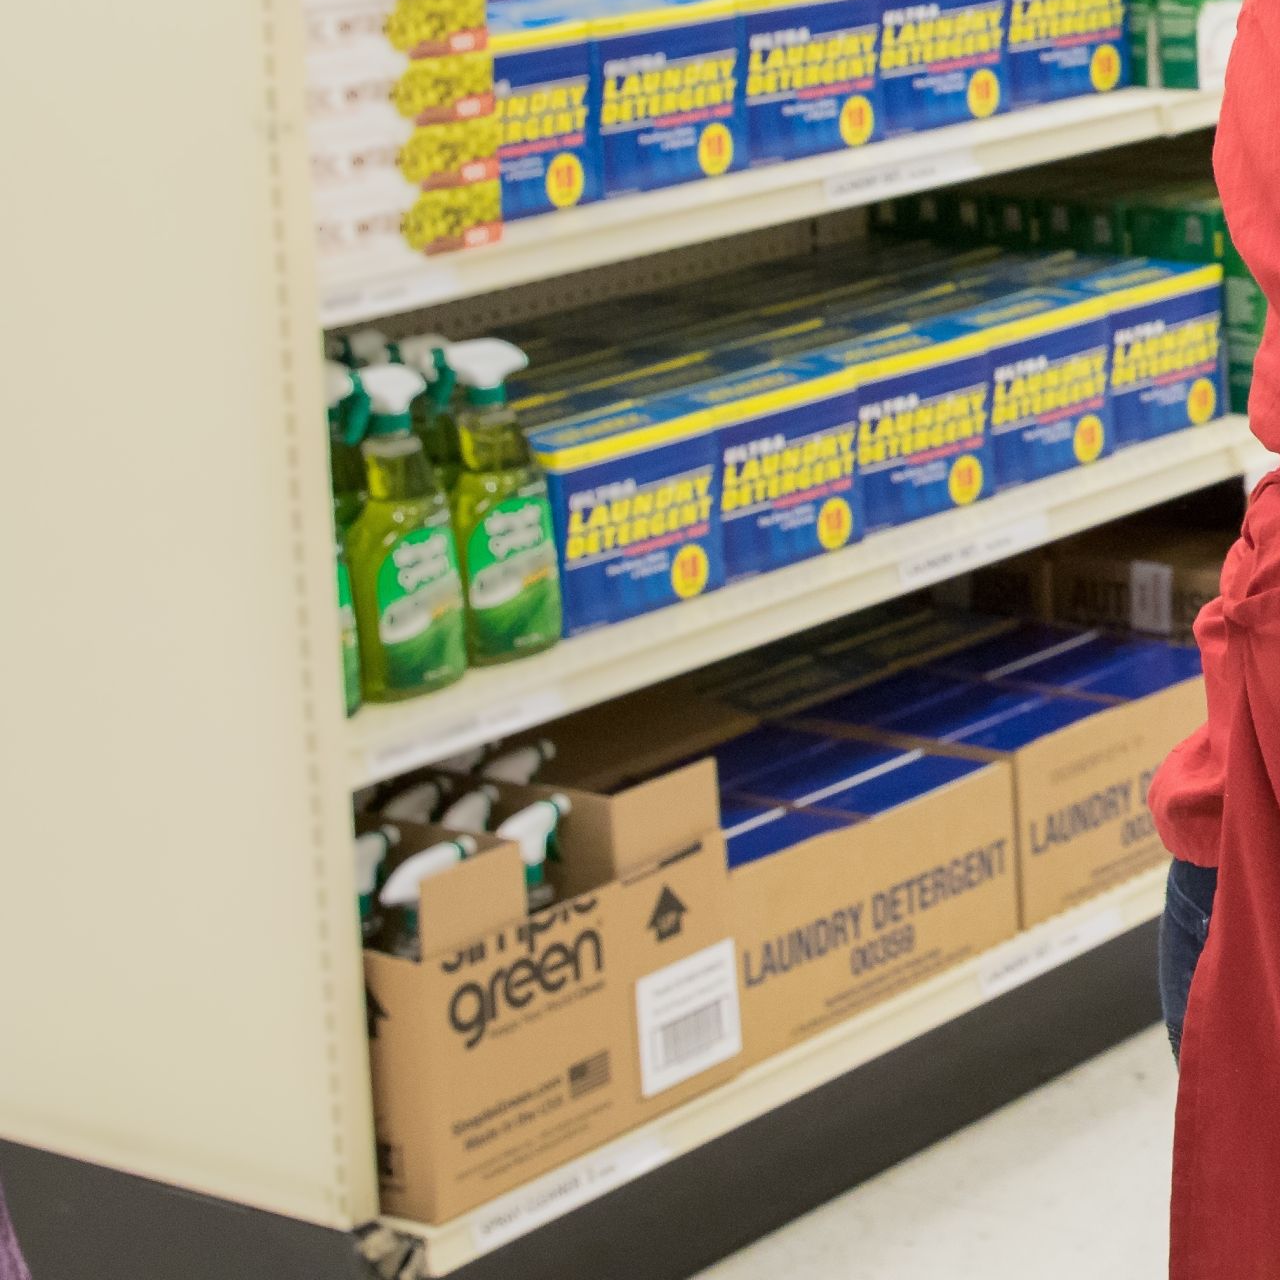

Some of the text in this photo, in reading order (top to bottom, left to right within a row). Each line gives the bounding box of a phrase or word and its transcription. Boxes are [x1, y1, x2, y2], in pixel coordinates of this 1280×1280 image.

[603, 57, 737, 102] LAUNDRY
[723, 431, 855, 489] LAUNDRY
[566, 495, 713, 560] DETERGENT
[568, 475, 712, 535] LAUNDRY
[1029, 777, 1133, 857] LAUNDRY
[743, 899, 865, 988] LAUNDRY
[871, 837, 1007, 931] DETERGENT
[448, 928, 603, 1050] green
